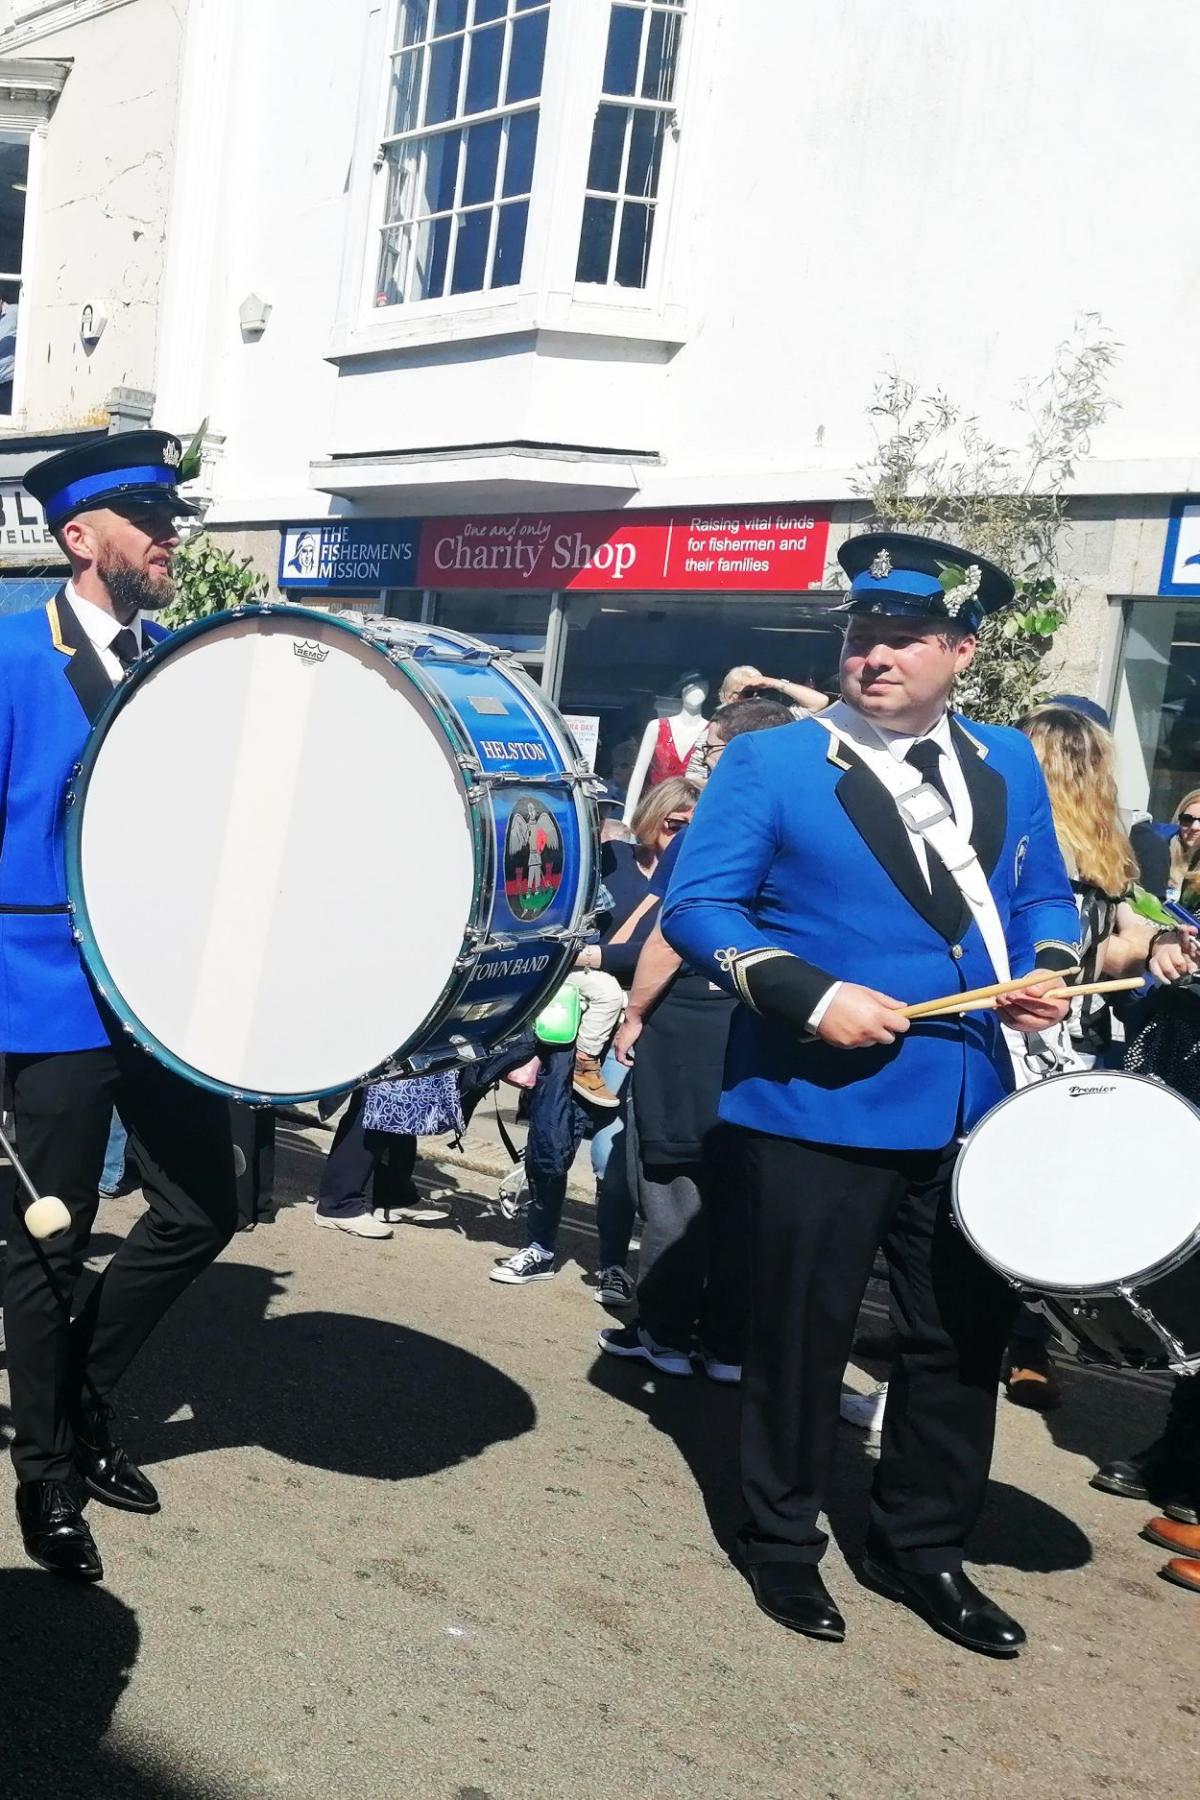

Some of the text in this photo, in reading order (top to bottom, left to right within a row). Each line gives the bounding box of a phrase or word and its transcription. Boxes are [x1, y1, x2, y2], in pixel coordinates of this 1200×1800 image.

[464, 518, 552, 542] One and only
[690, 515, 815, 534] Raising vital funds
[323, 527, 349, 543] THE
[687, 536, 807, 551] for fishermen and
[321, 543, 412, 561] FISHERMEN'S
[434, 532, 637, 578] Charity Shop
[319, 562, 380, 579] MISSION
[685, 557, 770, 572] their families
[297, 648, 324, 660] REMO
[481, 741, 547, 760] HELSTON
[469, 955, 550, 981] TOWN BAND
[1068, 1085, 1116, 1097] Premier
